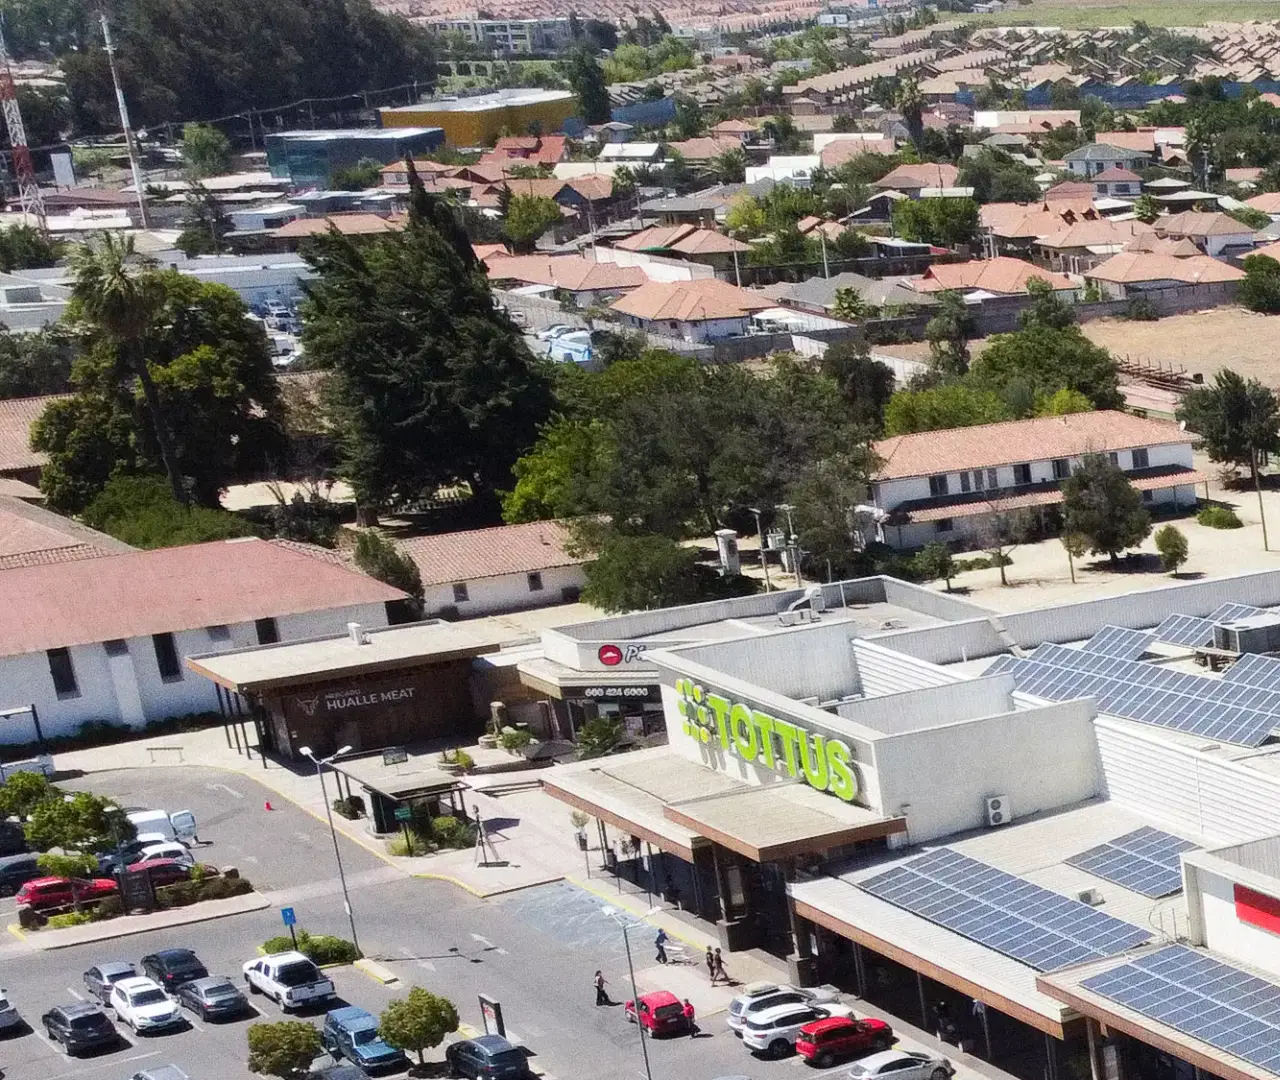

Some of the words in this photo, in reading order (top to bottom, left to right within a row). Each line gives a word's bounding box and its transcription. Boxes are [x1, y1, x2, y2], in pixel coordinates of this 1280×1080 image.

[326, 693, 378, 711] HUALLE
[380, 687, 416, 702] MEAT
[706, 692, 858, 801] TOTTUS
